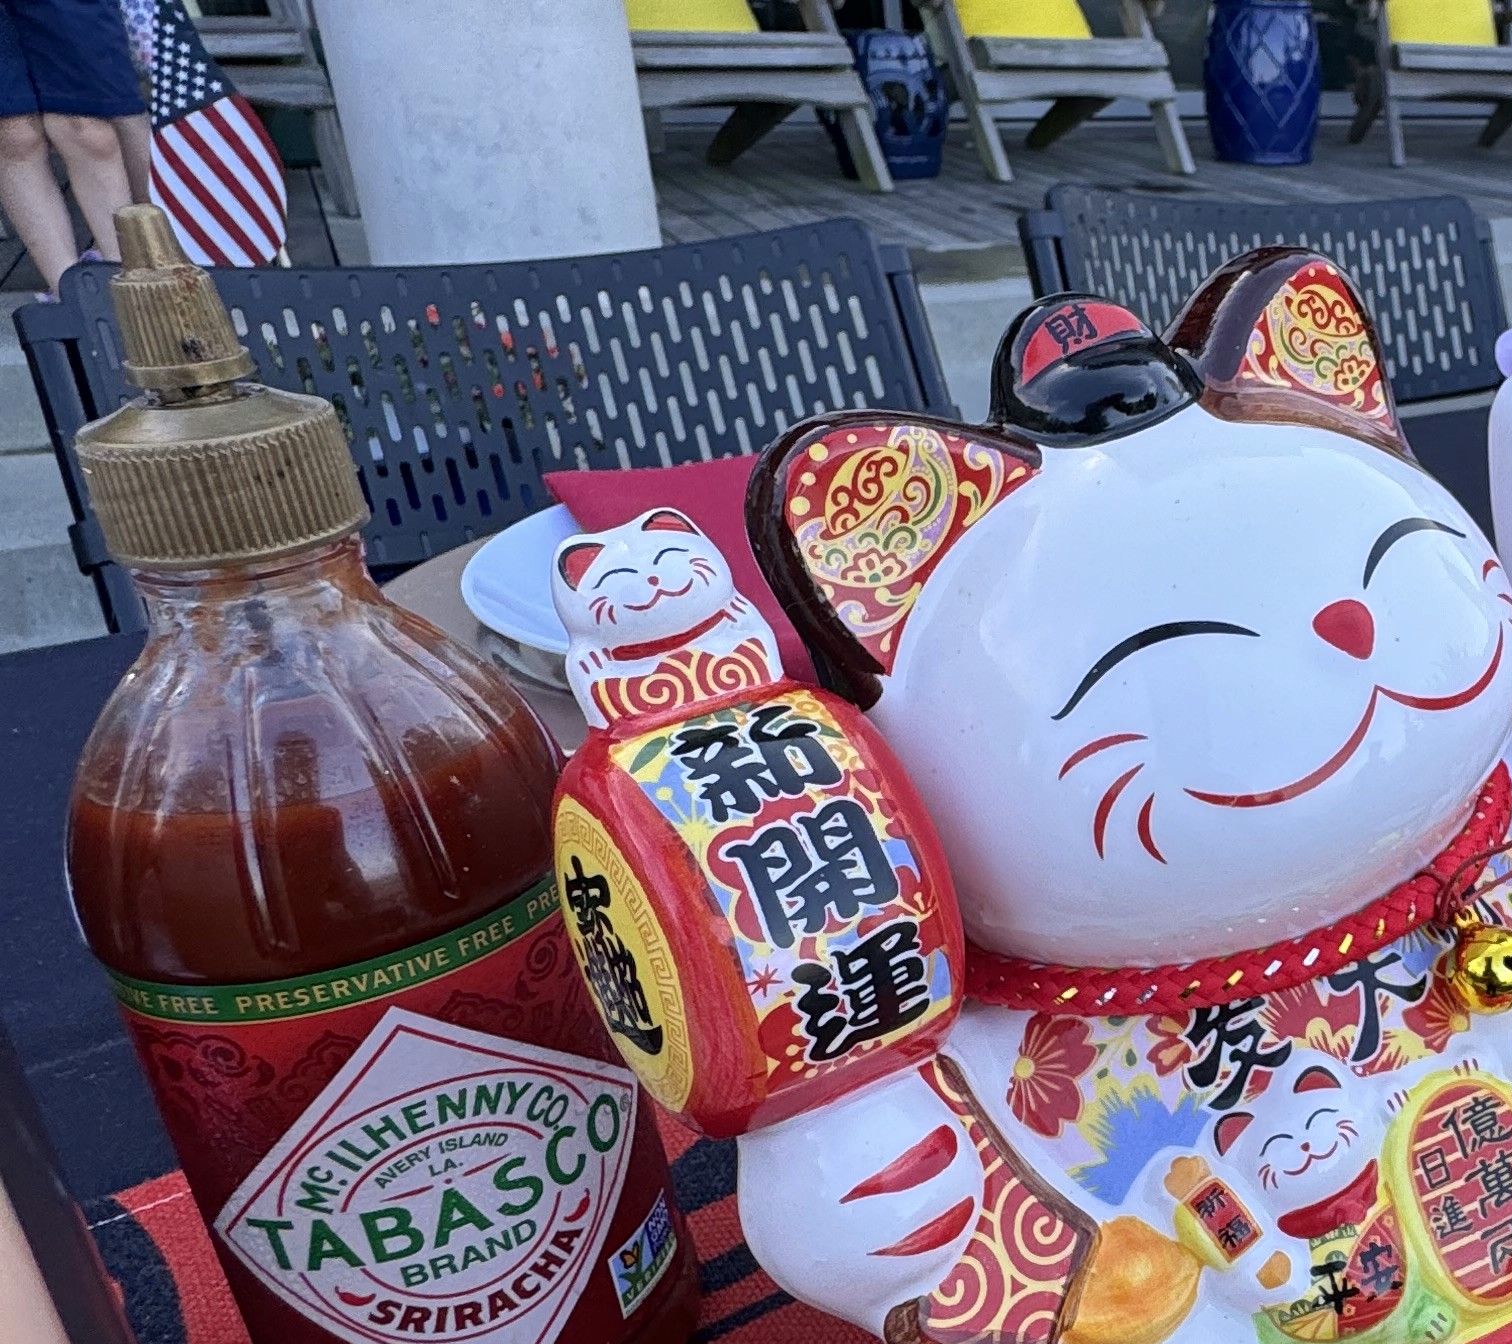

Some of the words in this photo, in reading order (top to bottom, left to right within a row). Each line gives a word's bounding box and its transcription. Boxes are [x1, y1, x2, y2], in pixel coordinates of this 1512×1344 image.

[1045, 303, 1098, 355] 財
[158, 993, 219, 1014] FREE
[237, 948, 451, 1015] PRESERVATIVE
[456, 917, 515, 955] FREE
[526, 885, 560, 919] PRE
[526, 1084, 569, 1131] CO.
[246, 1093, 620, 1272] TABASCO
[374, 1142, 431, 1189] AVERY
[439, 1132, 508, 1154] ISLAND
[428, 1160, 463, 1177] LA.
[1420, 1147, 1473, 1239] 日進
[368, 1227, 585, 1334] SRIRACHA
[401, 1219, 537, 1288] BRAND
[1310, 1242, 1403, 1315] 平安
